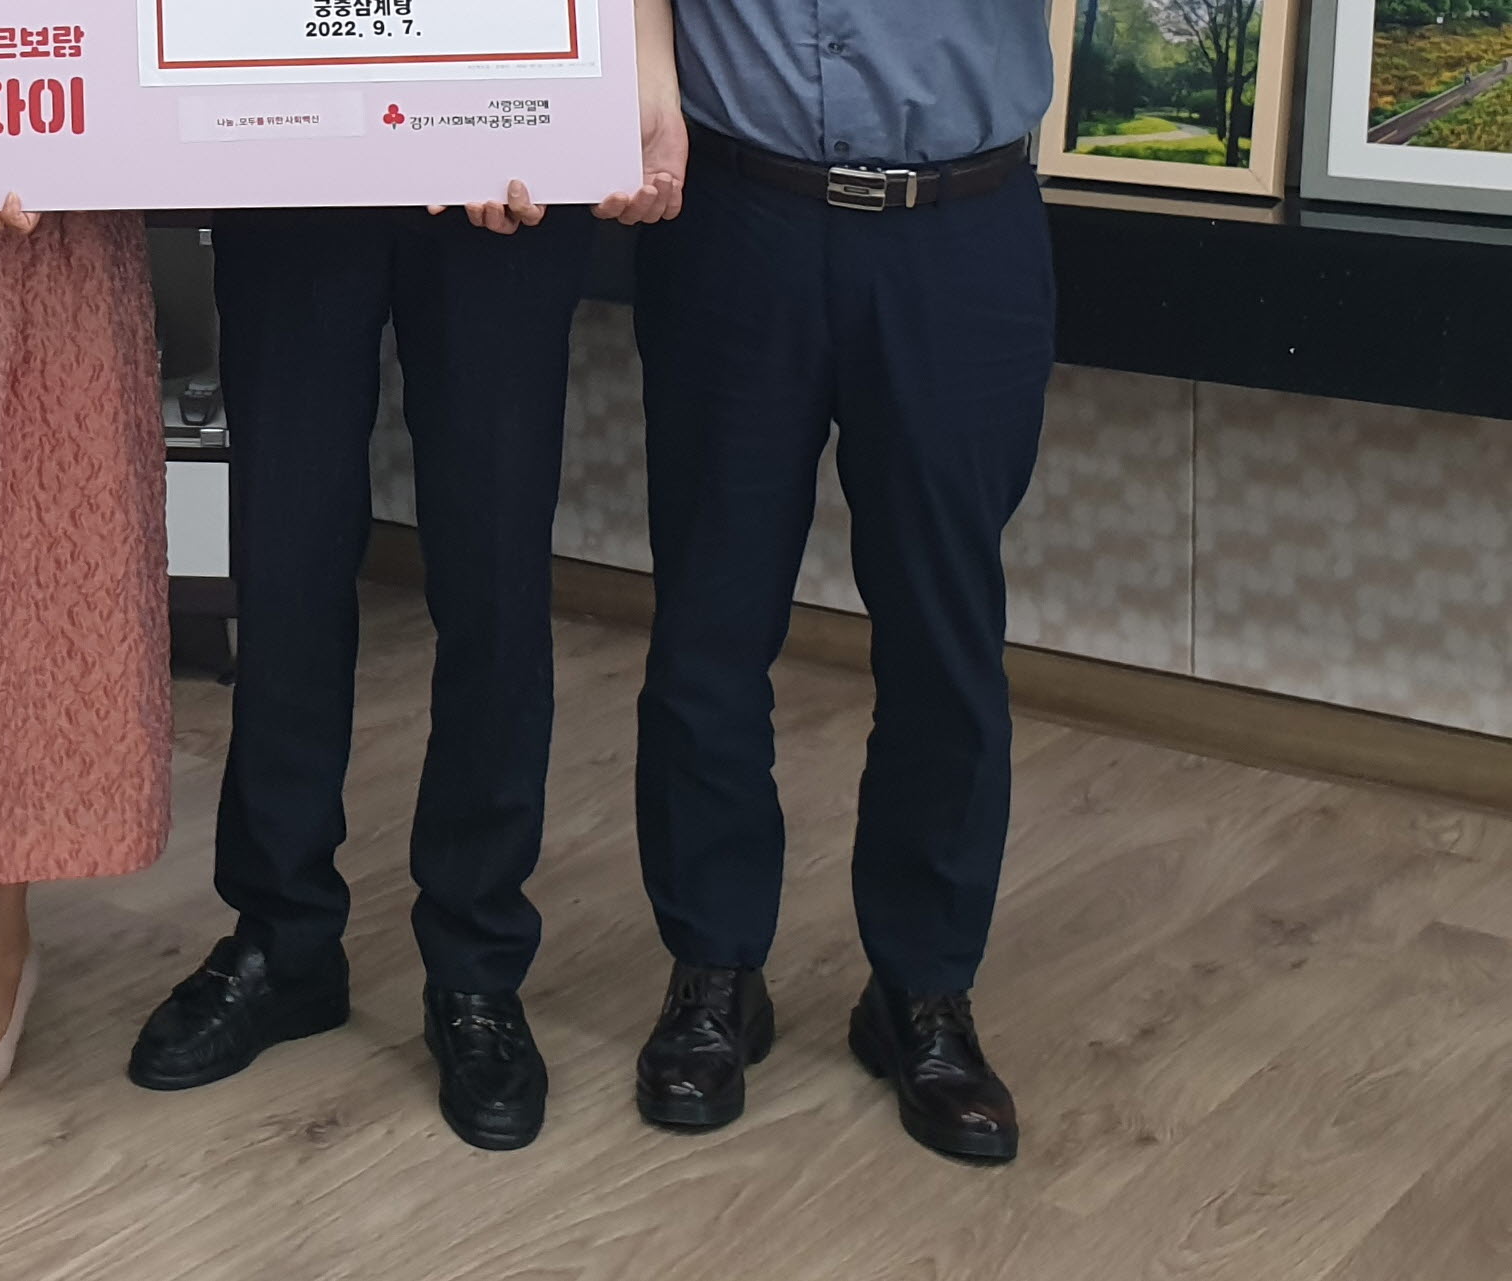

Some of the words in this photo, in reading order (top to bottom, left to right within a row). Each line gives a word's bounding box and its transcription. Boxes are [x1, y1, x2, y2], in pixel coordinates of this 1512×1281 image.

[305, 21, 364, 38] 2022.
[373, 20, 393, 37] 9.
[401, 19, 422, 37] 7.
[488, 99, 550, 113] 사랑의열매
[266, 115, 284, 125] 위한
[285, 114, 320, 125] 사회백신
[409, 116, 435, 131] 경기
[438, 114, 551, 129] 사회복지공동모금회
